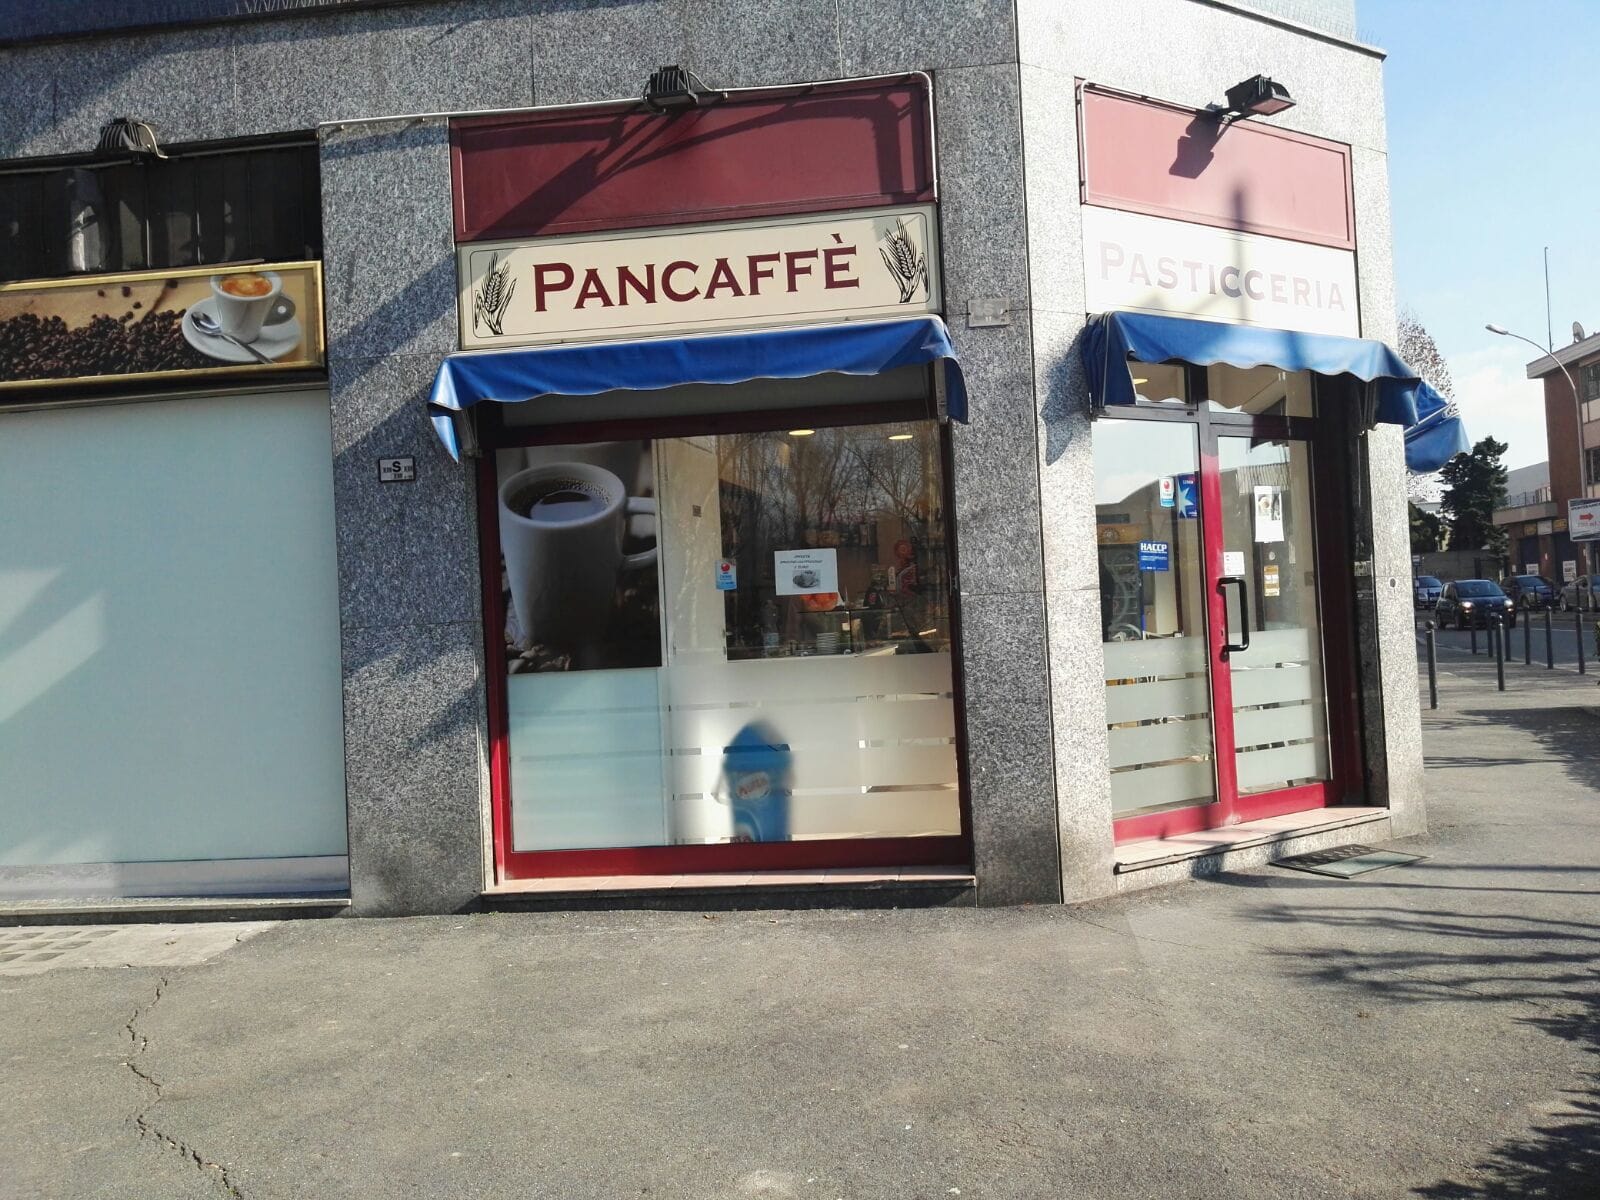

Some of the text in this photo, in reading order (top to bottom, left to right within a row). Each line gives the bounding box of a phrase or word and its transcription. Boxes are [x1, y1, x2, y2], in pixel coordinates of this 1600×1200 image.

[533, 233, 860, 312] PANCAFFÈ
[1099, 241, 1345, 311] PASTICCERIA
[392, 461, 402, 472] S
[1140, 543, 1168, 552] HACCP
